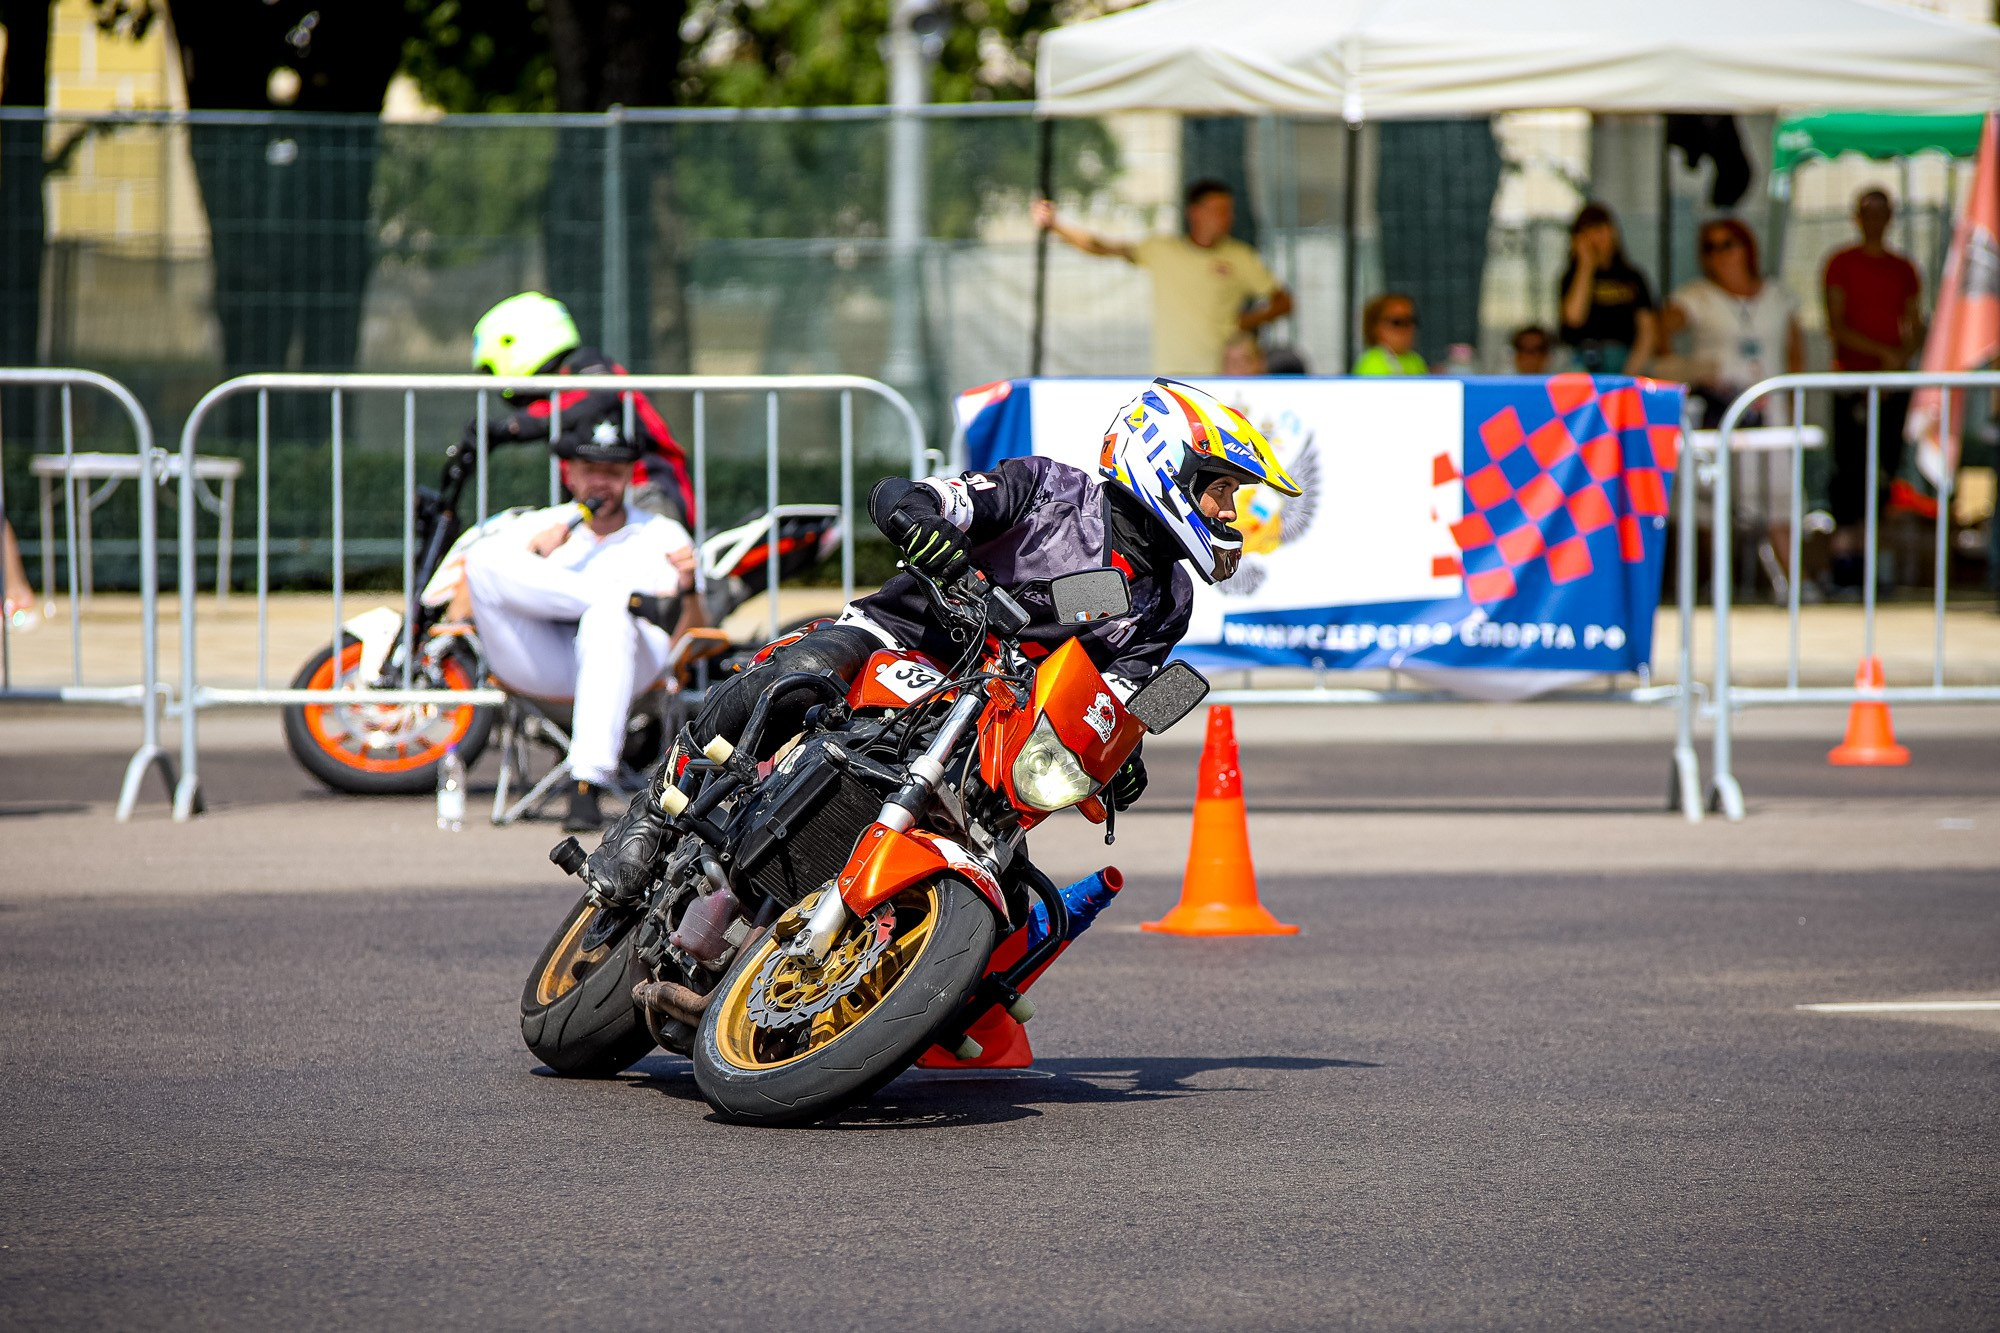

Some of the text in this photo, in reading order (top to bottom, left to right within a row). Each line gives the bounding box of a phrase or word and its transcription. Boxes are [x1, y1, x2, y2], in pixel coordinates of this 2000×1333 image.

[1459, 621, 1577, 650] СПОРТА
[1583, 623, 1627, 650] РФ
[895, 665, 936, 689] 39
